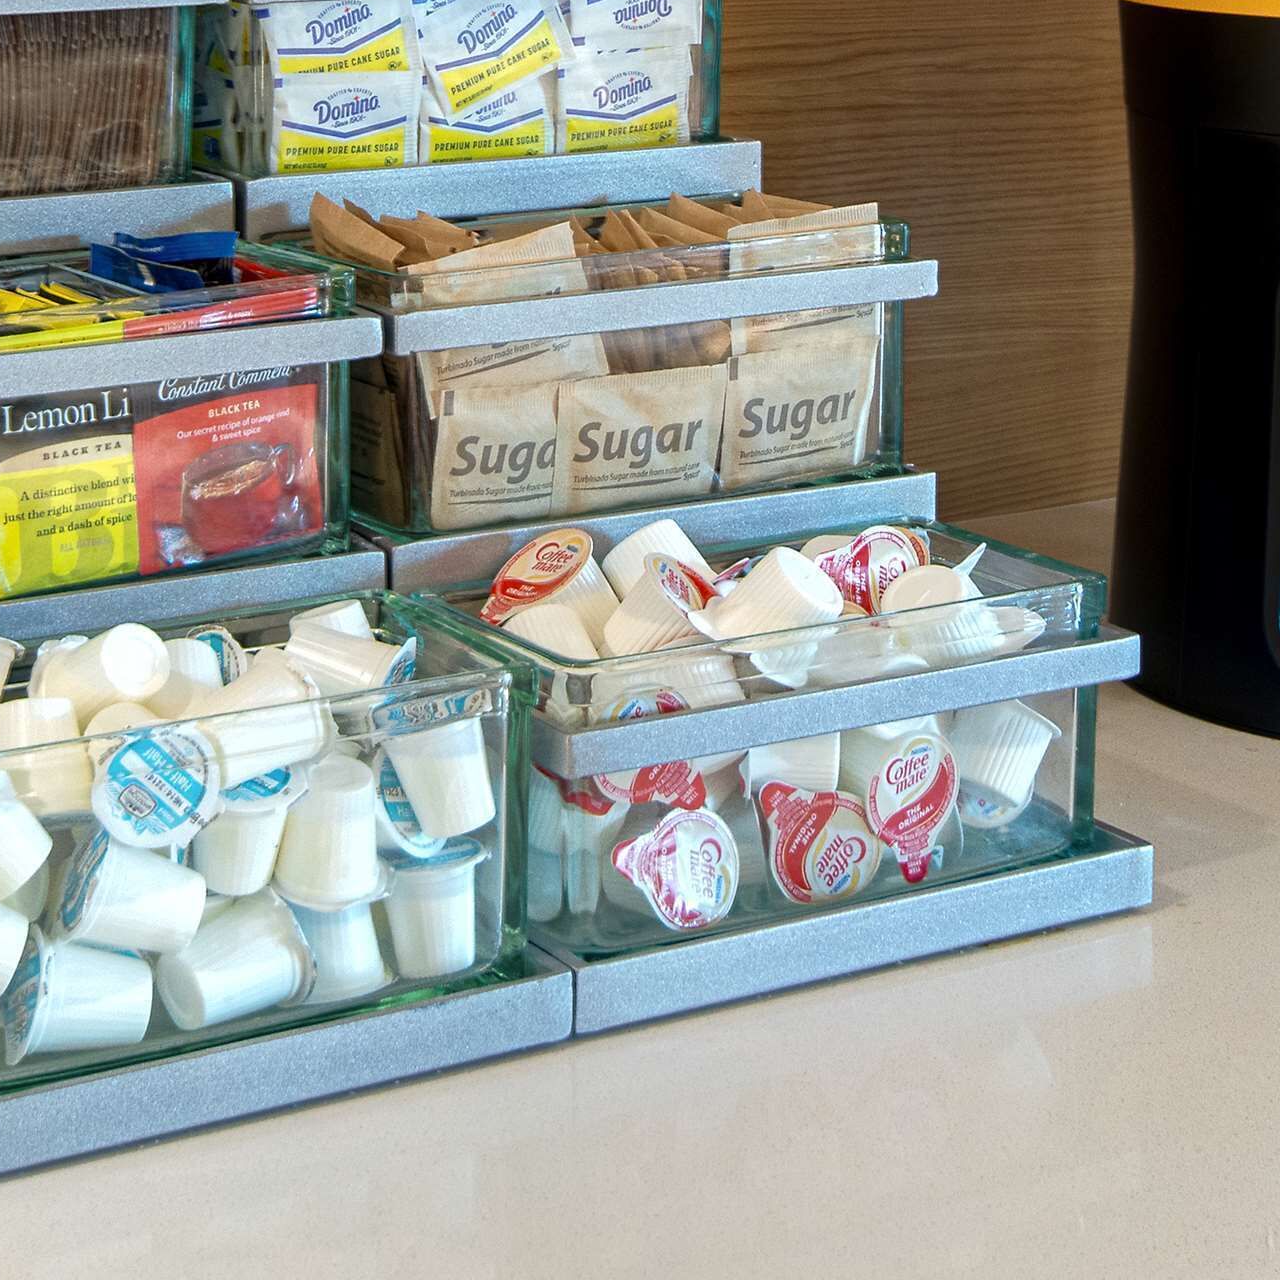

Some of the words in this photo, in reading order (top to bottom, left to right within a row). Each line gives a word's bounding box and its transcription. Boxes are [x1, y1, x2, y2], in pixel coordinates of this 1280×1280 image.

[305, 4, 373, 45] Domino
[457, 4, 517, 54] Domino
[328, 59, 349, 71] PURE
[351, 54, 372, 67] CANE
[375, 46, 400, 61] SUGAR
[451, 73, 485, 95] PREMIUM
[487, 62, 506, 77] PURE
[507, 51, 526, 67] CANE
[528, 38, 550, 56] SUGAR
[593, 76, 653, 109] Domino
[313, 95, 380, 124] Domino
[434, 142, 471, 151] PREMIUM
[473, 140, 492, 149] PURE
[495, 137, 514, 147] CANE
[516, 135, 539, 145] SUGAR
[571, 131, 606, 141] PREMIUM
[608, 128, 627, 137] PURE
[629, 125, 648, 134] CANE
[650, 120, 673, 130] SUGAR
[286, 146, 324, 157] PREMIUM
[328, 146, 348, 154] PURE
[351, 144, 371, 153] CANE
[375, 142, 399, 152] SUGAR
[473, 353, 494, 368] Sugar
[494, 347, 514, 360] made
[158, 373, 226, 401] Constant
[229, 365, 291, 390] Comment
[1, 404, 97, 435] Lemon
[208, 403, 240, 418] BLACK
[243, 400, 261, 410] TEA
[738, 389, 856, 441] Sugar
[176, 430, 192, 439] Our
[193, 425, 217, 437] secret
[217, 421, 241, 434] recipe
[242, 416, 251, 426] of
[250, 413, 276, 426] orange
[211, 432, 219, 441] &
[220, 430, 242, 440] sweet
[243, 426, 262, 438] spice
[42, 446, 89, 461] BLACK
[95, 441, 122, 452] TEA
[573, 419, 703, 469] Sugar
[772, 444, 790, 454] Sugar
[573, 472, 609, 483] Turbinado
[609, 470, 629, 481] Sugar
[629, 469, 649, 478] made
[649, 467, 664, 477] from
[20, 491, 30, 501] A
[32, 480, 89, 500] distinctive
[91, 476, 119, 489] blend
[485, 486, 506, 496] Sugar
[3, 512, 26, 524] just
[27, 508, 45, 520] the
[47, 504, 73, 520] right
[74, 499, 116, 512] amount
[117, 494, 127, 505] of
[36, 526, 56, 537] and
[67, 520, 93, 532] dash
[94, 517, 105, 527] of
[106, 513, 133, 527] spice
[536, 542, 574, 563] Coffee
[531, 560, 564, 573] mate
[886, 753, 929, 785] Coffee
[895, 767, 927, 795] mate
[898, 804, 934, 830] ORIGINAL
[907, 803, 922, 817] THE
[788, 812, 817, 854] ORIGINAL
[802, 827, 816, 846] THE
[816, 834, 844, 873] mate
[824, 836, 867, 887] Coffee
[690, 849, 702, 894] mate
[700, 838, 722, 899] Coffee
